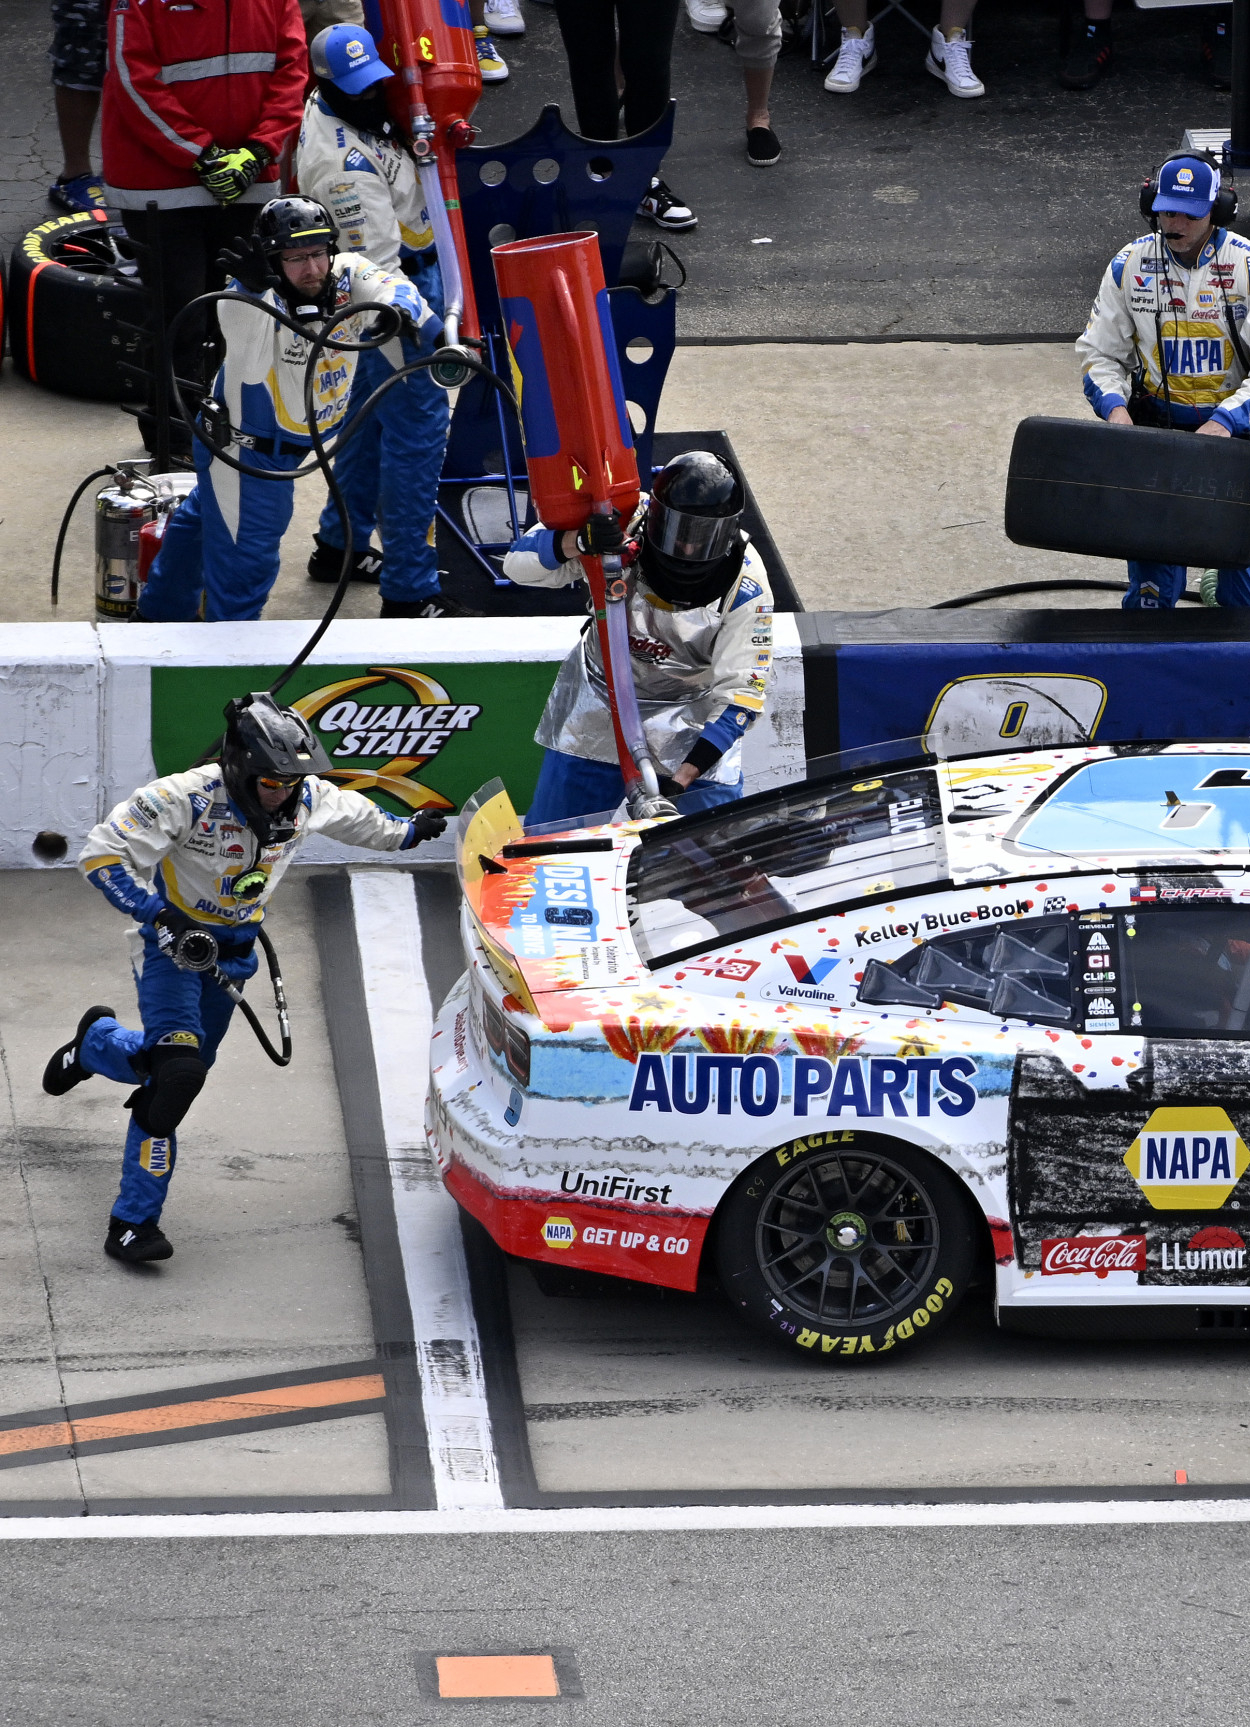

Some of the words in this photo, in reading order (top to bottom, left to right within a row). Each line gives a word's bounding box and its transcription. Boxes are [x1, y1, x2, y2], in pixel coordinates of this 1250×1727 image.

[1199, 296, 1213, 304] NAPA
[1163, 339, 1223, 374] NAPA
[319, 701, 480, 731] QUAKER
[333, 731, 451, 756] STATE
[1160, 888, 1235, 898] CHASE
[855, 920, 920, 947] Kelley
[925, 909, 972, 931] Blue
[977, 899, 1029, 921] Book
[521, 924, 545, 955] DRIVE
[606, 945, 619, 974] Celebration
[778, 984, 836, 1002] Valvoline
[1088, 997, 1115, 1009] MAC
[629, 1055, 780, 1116] AUTO
[793, 1056, 977, 1117] PARTS
[151, 1139, 167, 1172] NAPA
[775, 1129, 855, 1168] EAGLE
[1146, 1136, 1231, 1180] NAPA
[560, 1171, 672, 1205] UniFirst
[547, 1224, 572, 1240] NAPA
[582, 1226, 617, 1245] GET
[620, 1231, 645, 1249] UP
[646, 1235, 661, 1251] &
[663, 1237, 689, 1255] GO
[1045, 1238, 1144, 1271] Coca-Cola
[1161, 1242, 1247, 1270] LLumar
[796, 1277, 954, 1355] GOODYEAR
